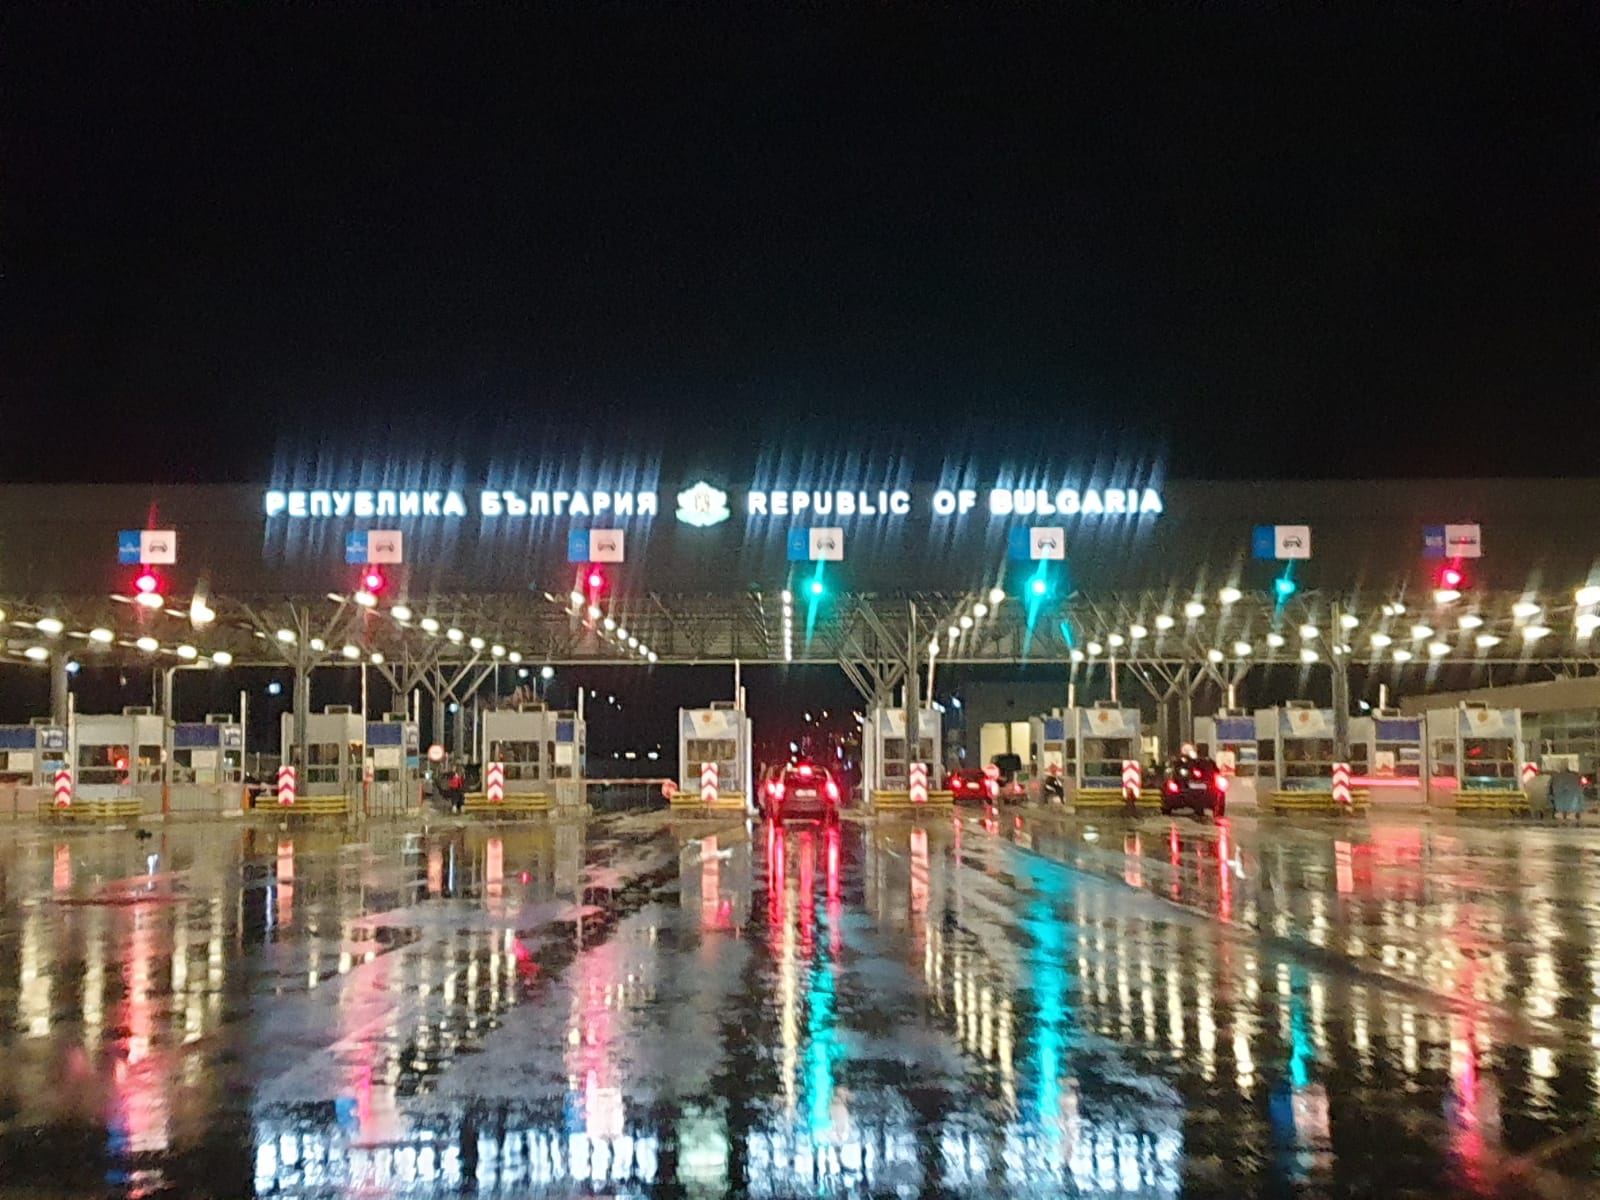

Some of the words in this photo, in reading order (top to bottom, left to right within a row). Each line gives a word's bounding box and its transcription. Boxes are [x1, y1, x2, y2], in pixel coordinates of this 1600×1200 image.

[265, 490, 466, 517] РЕПУБЛИКА
[480, 490, 658, 517] БЪЛГАРИЯ
[747, 490, 910, 516] REPUBLIC
[932, 489, 977, 515] OF
[988, 487, 1163, 515] BULGARIA
